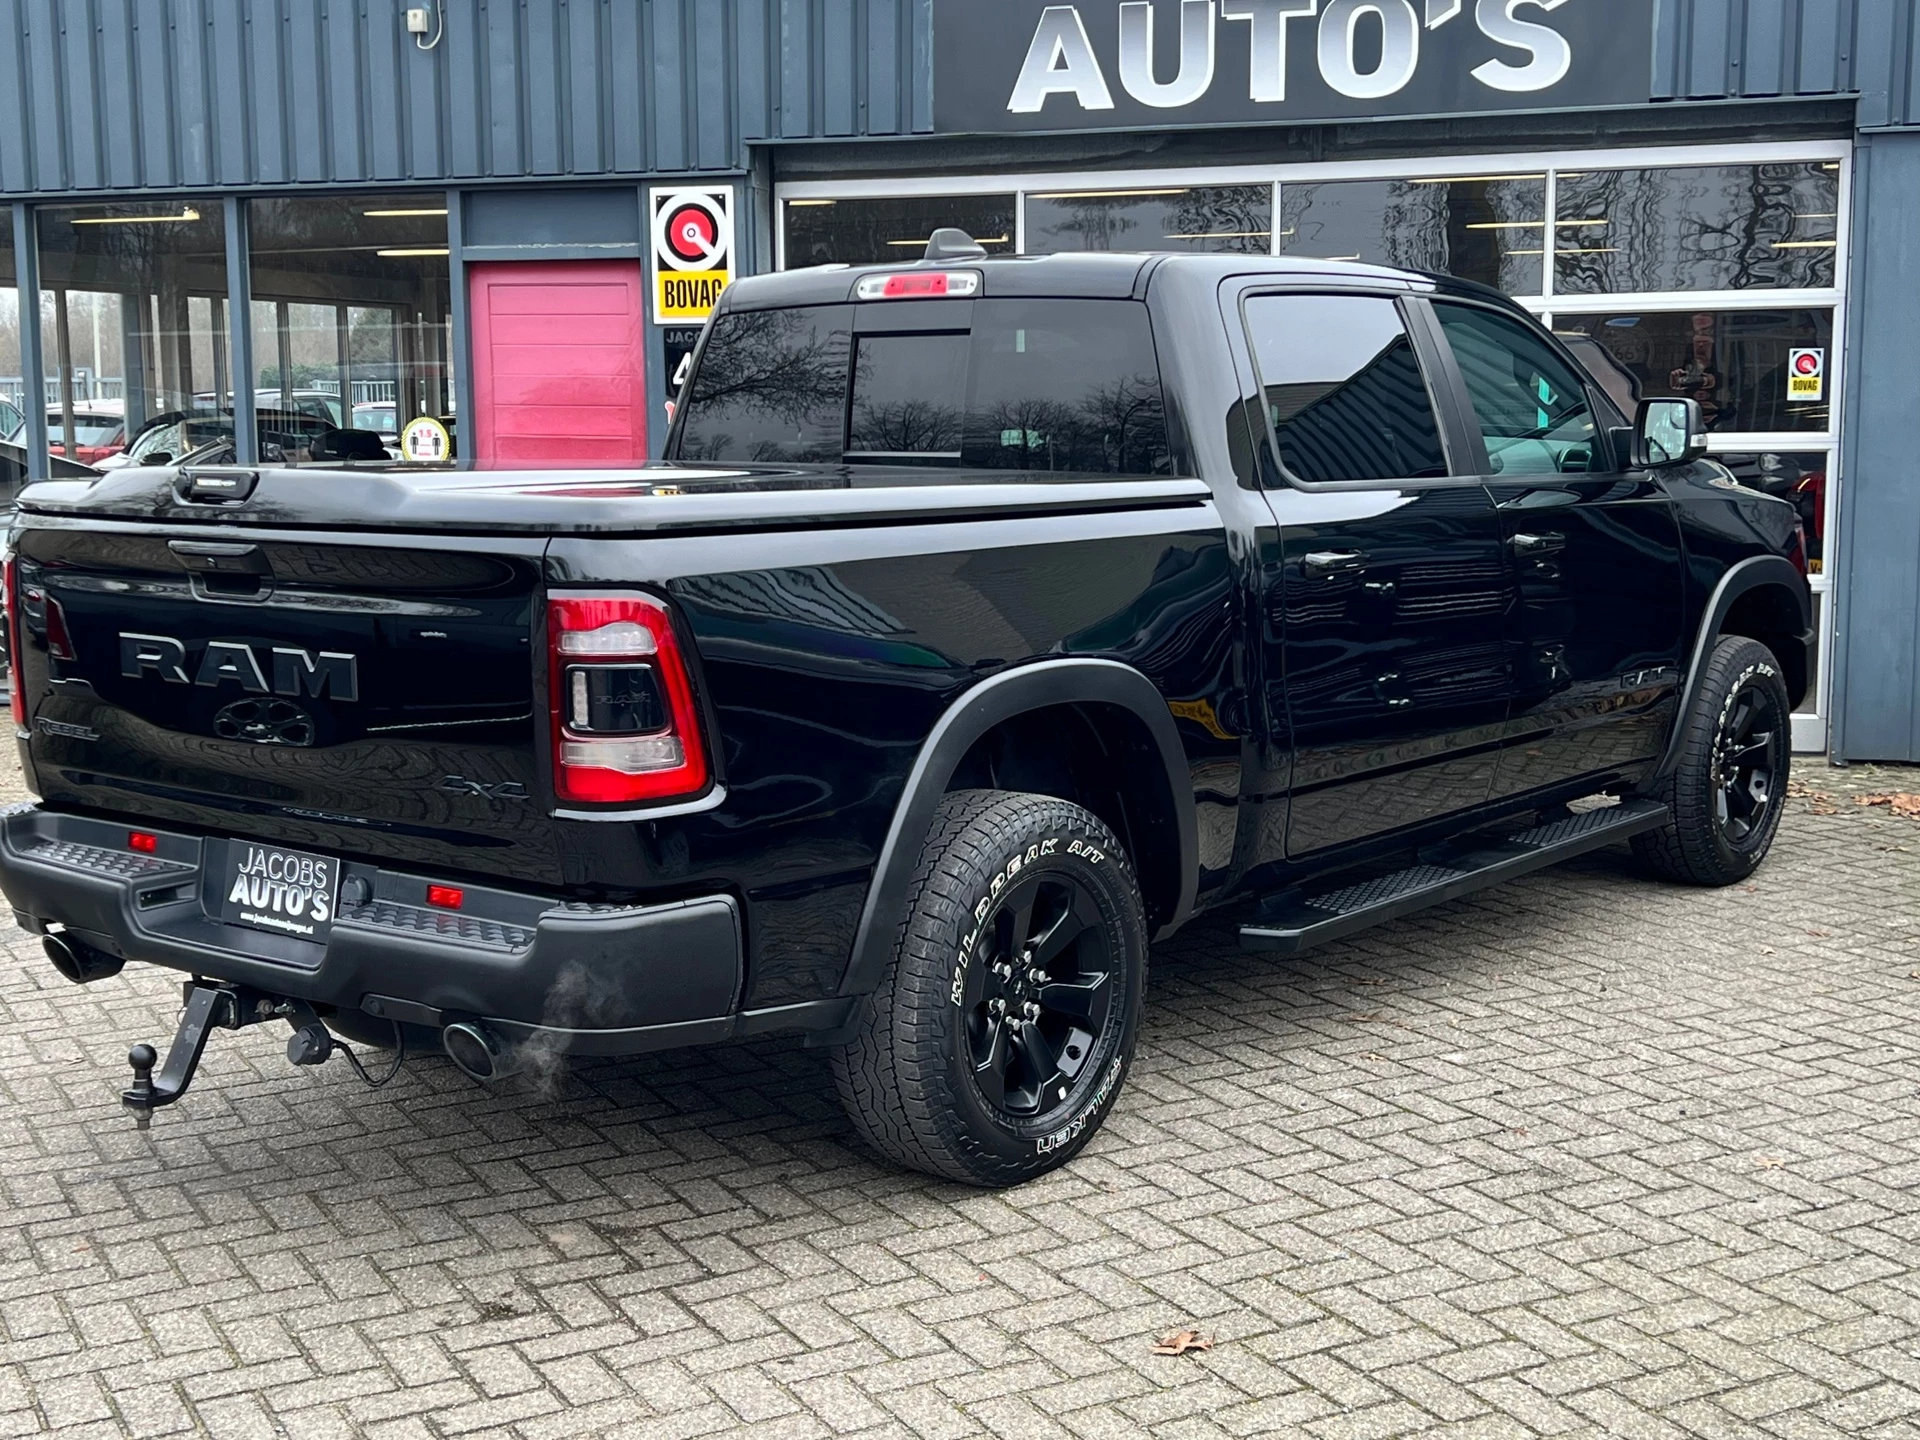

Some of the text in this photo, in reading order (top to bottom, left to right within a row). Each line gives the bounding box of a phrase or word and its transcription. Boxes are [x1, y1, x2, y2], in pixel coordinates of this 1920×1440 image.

[1007, 0, 1571, 112] AUTO'S
[1792, 379, 1818, 391] BOVAG
[119, 631, 358, 701] RAM
[228, 873, 330, 922] AUTO'S
[238, 847, 328, 889] JACOBS
[951, 838, 1059, 1007] WILDPEAK
